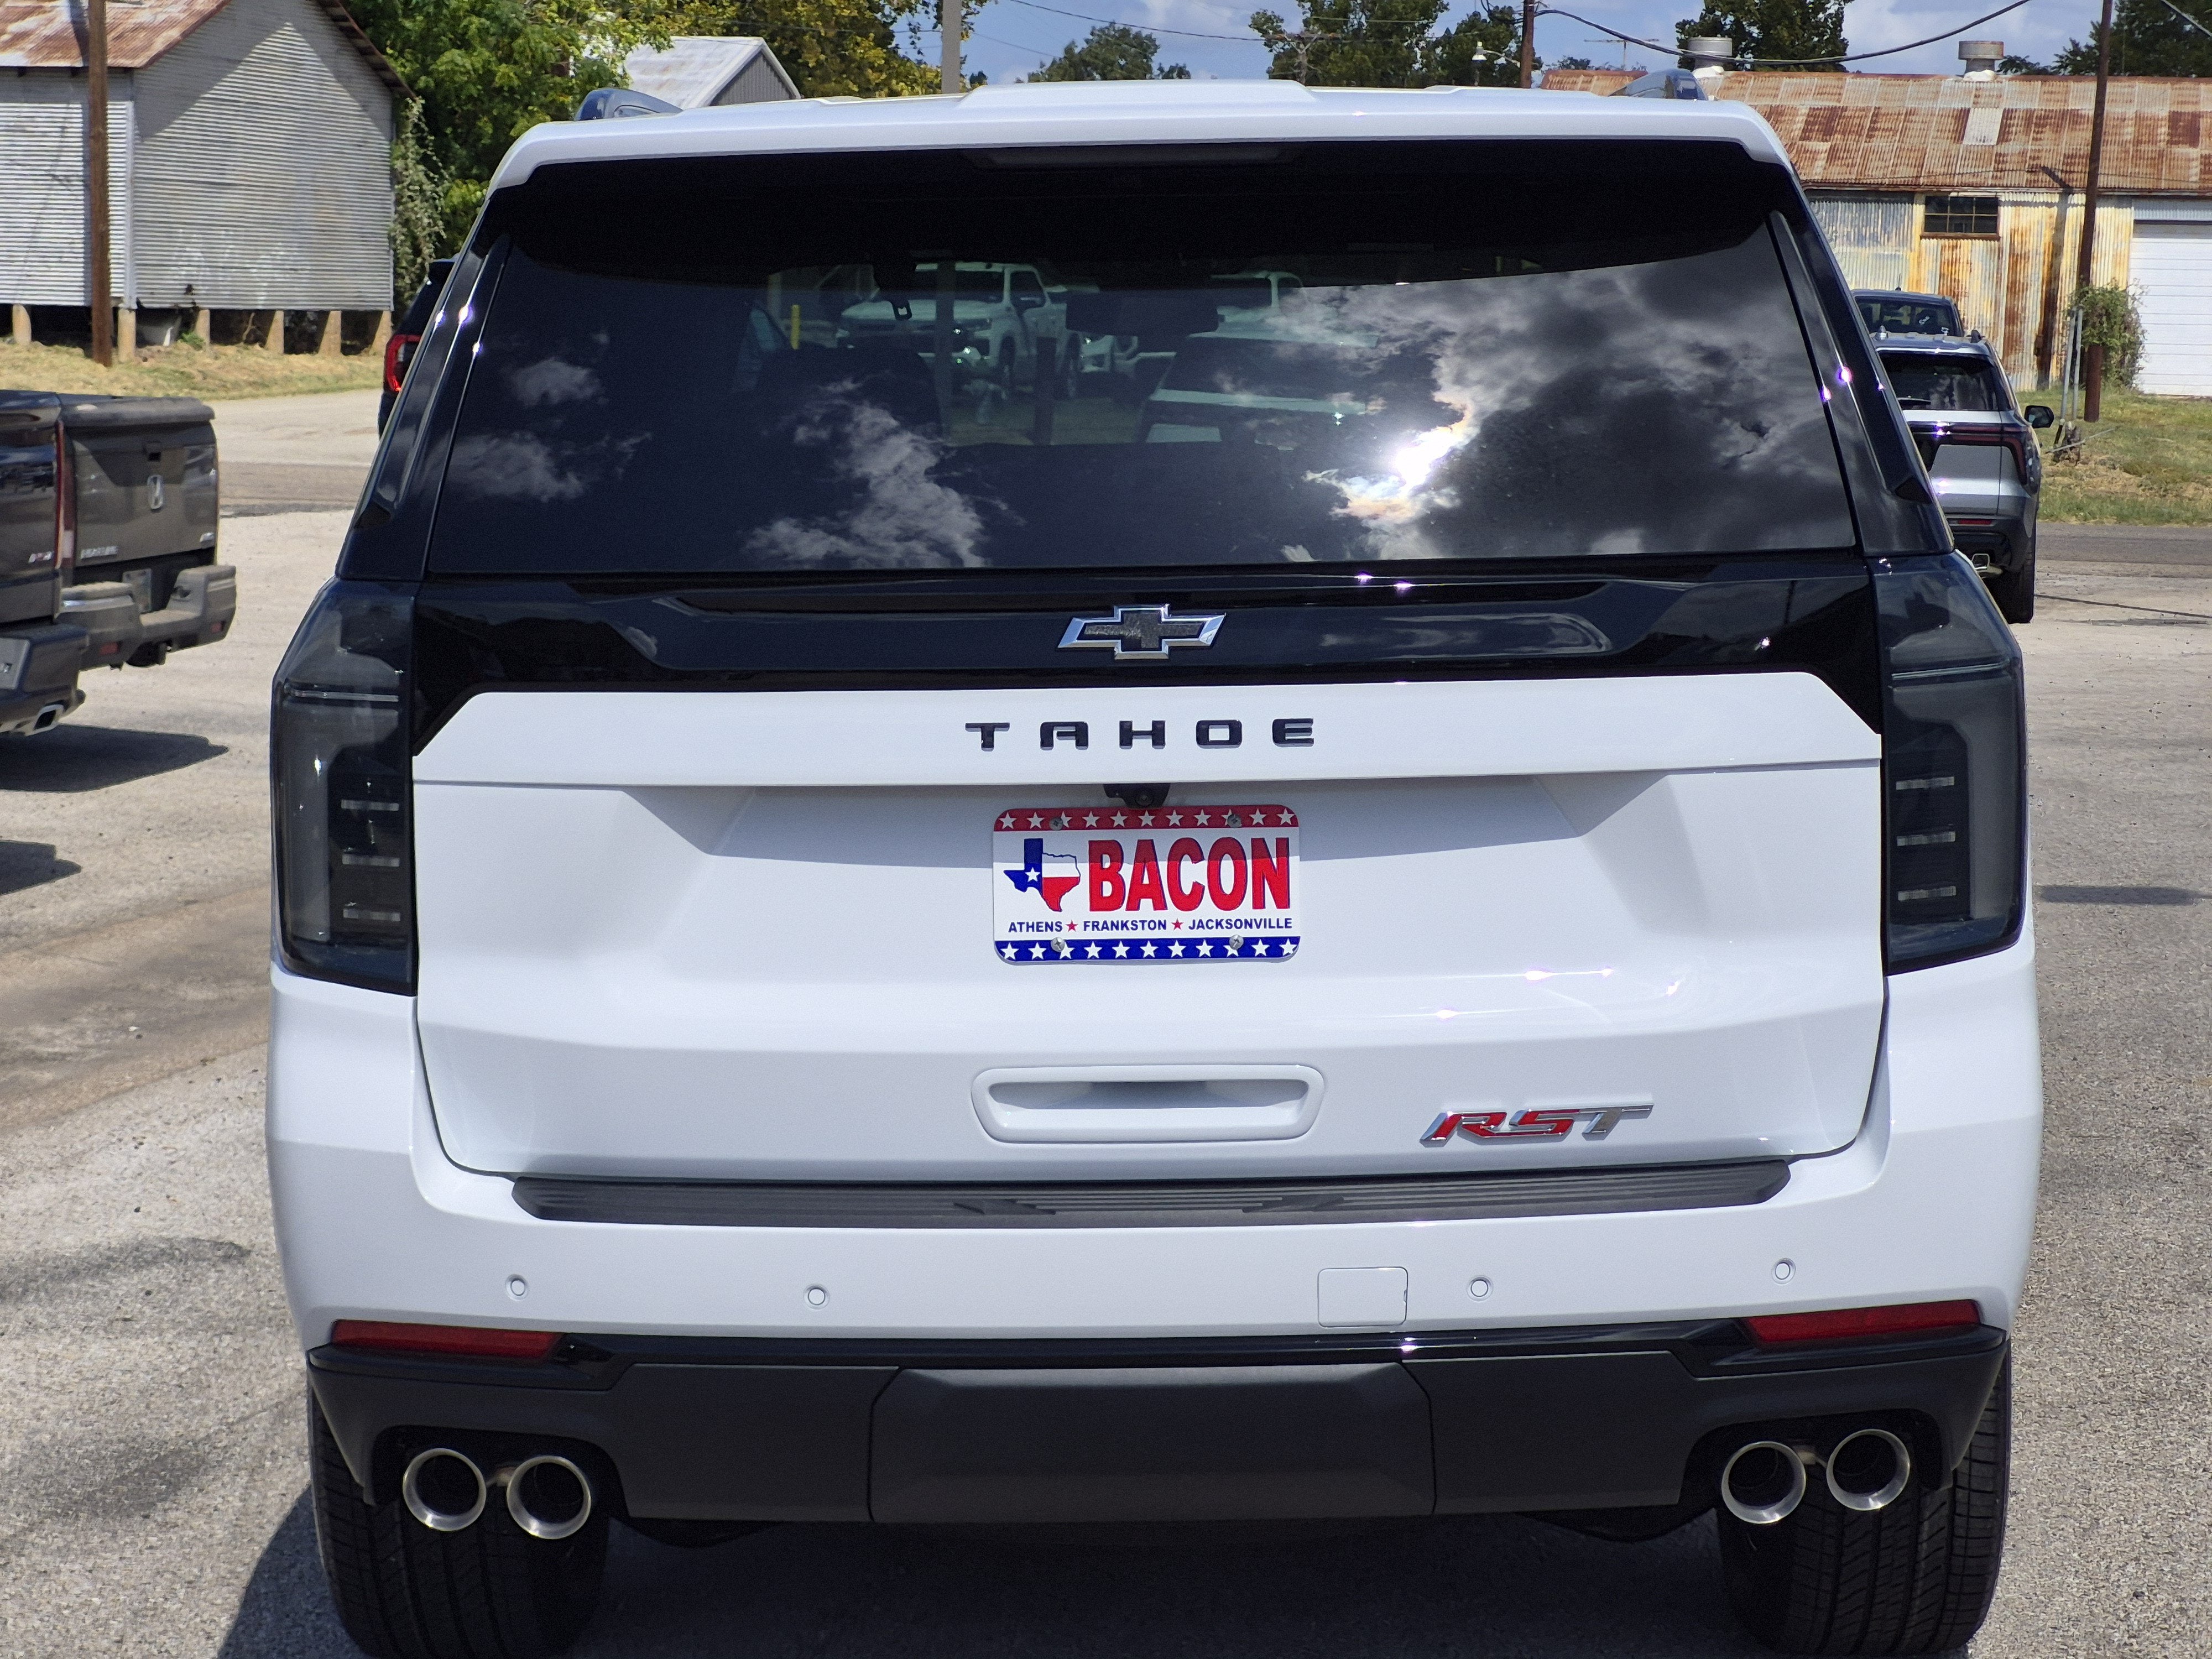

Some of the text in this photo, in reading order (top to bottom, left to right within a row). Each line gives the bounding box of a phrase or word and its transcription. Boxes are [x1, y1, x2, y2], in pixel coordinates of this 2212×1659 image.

[965, 717, 1314, 751] TAHOE
[1088, 836, 1291, 912] BACON
[1008, 917, 1293, 933] ATHENS FRANKSTON JACKSONVILLE
[1419, 1104, 1654, 1146] RST
